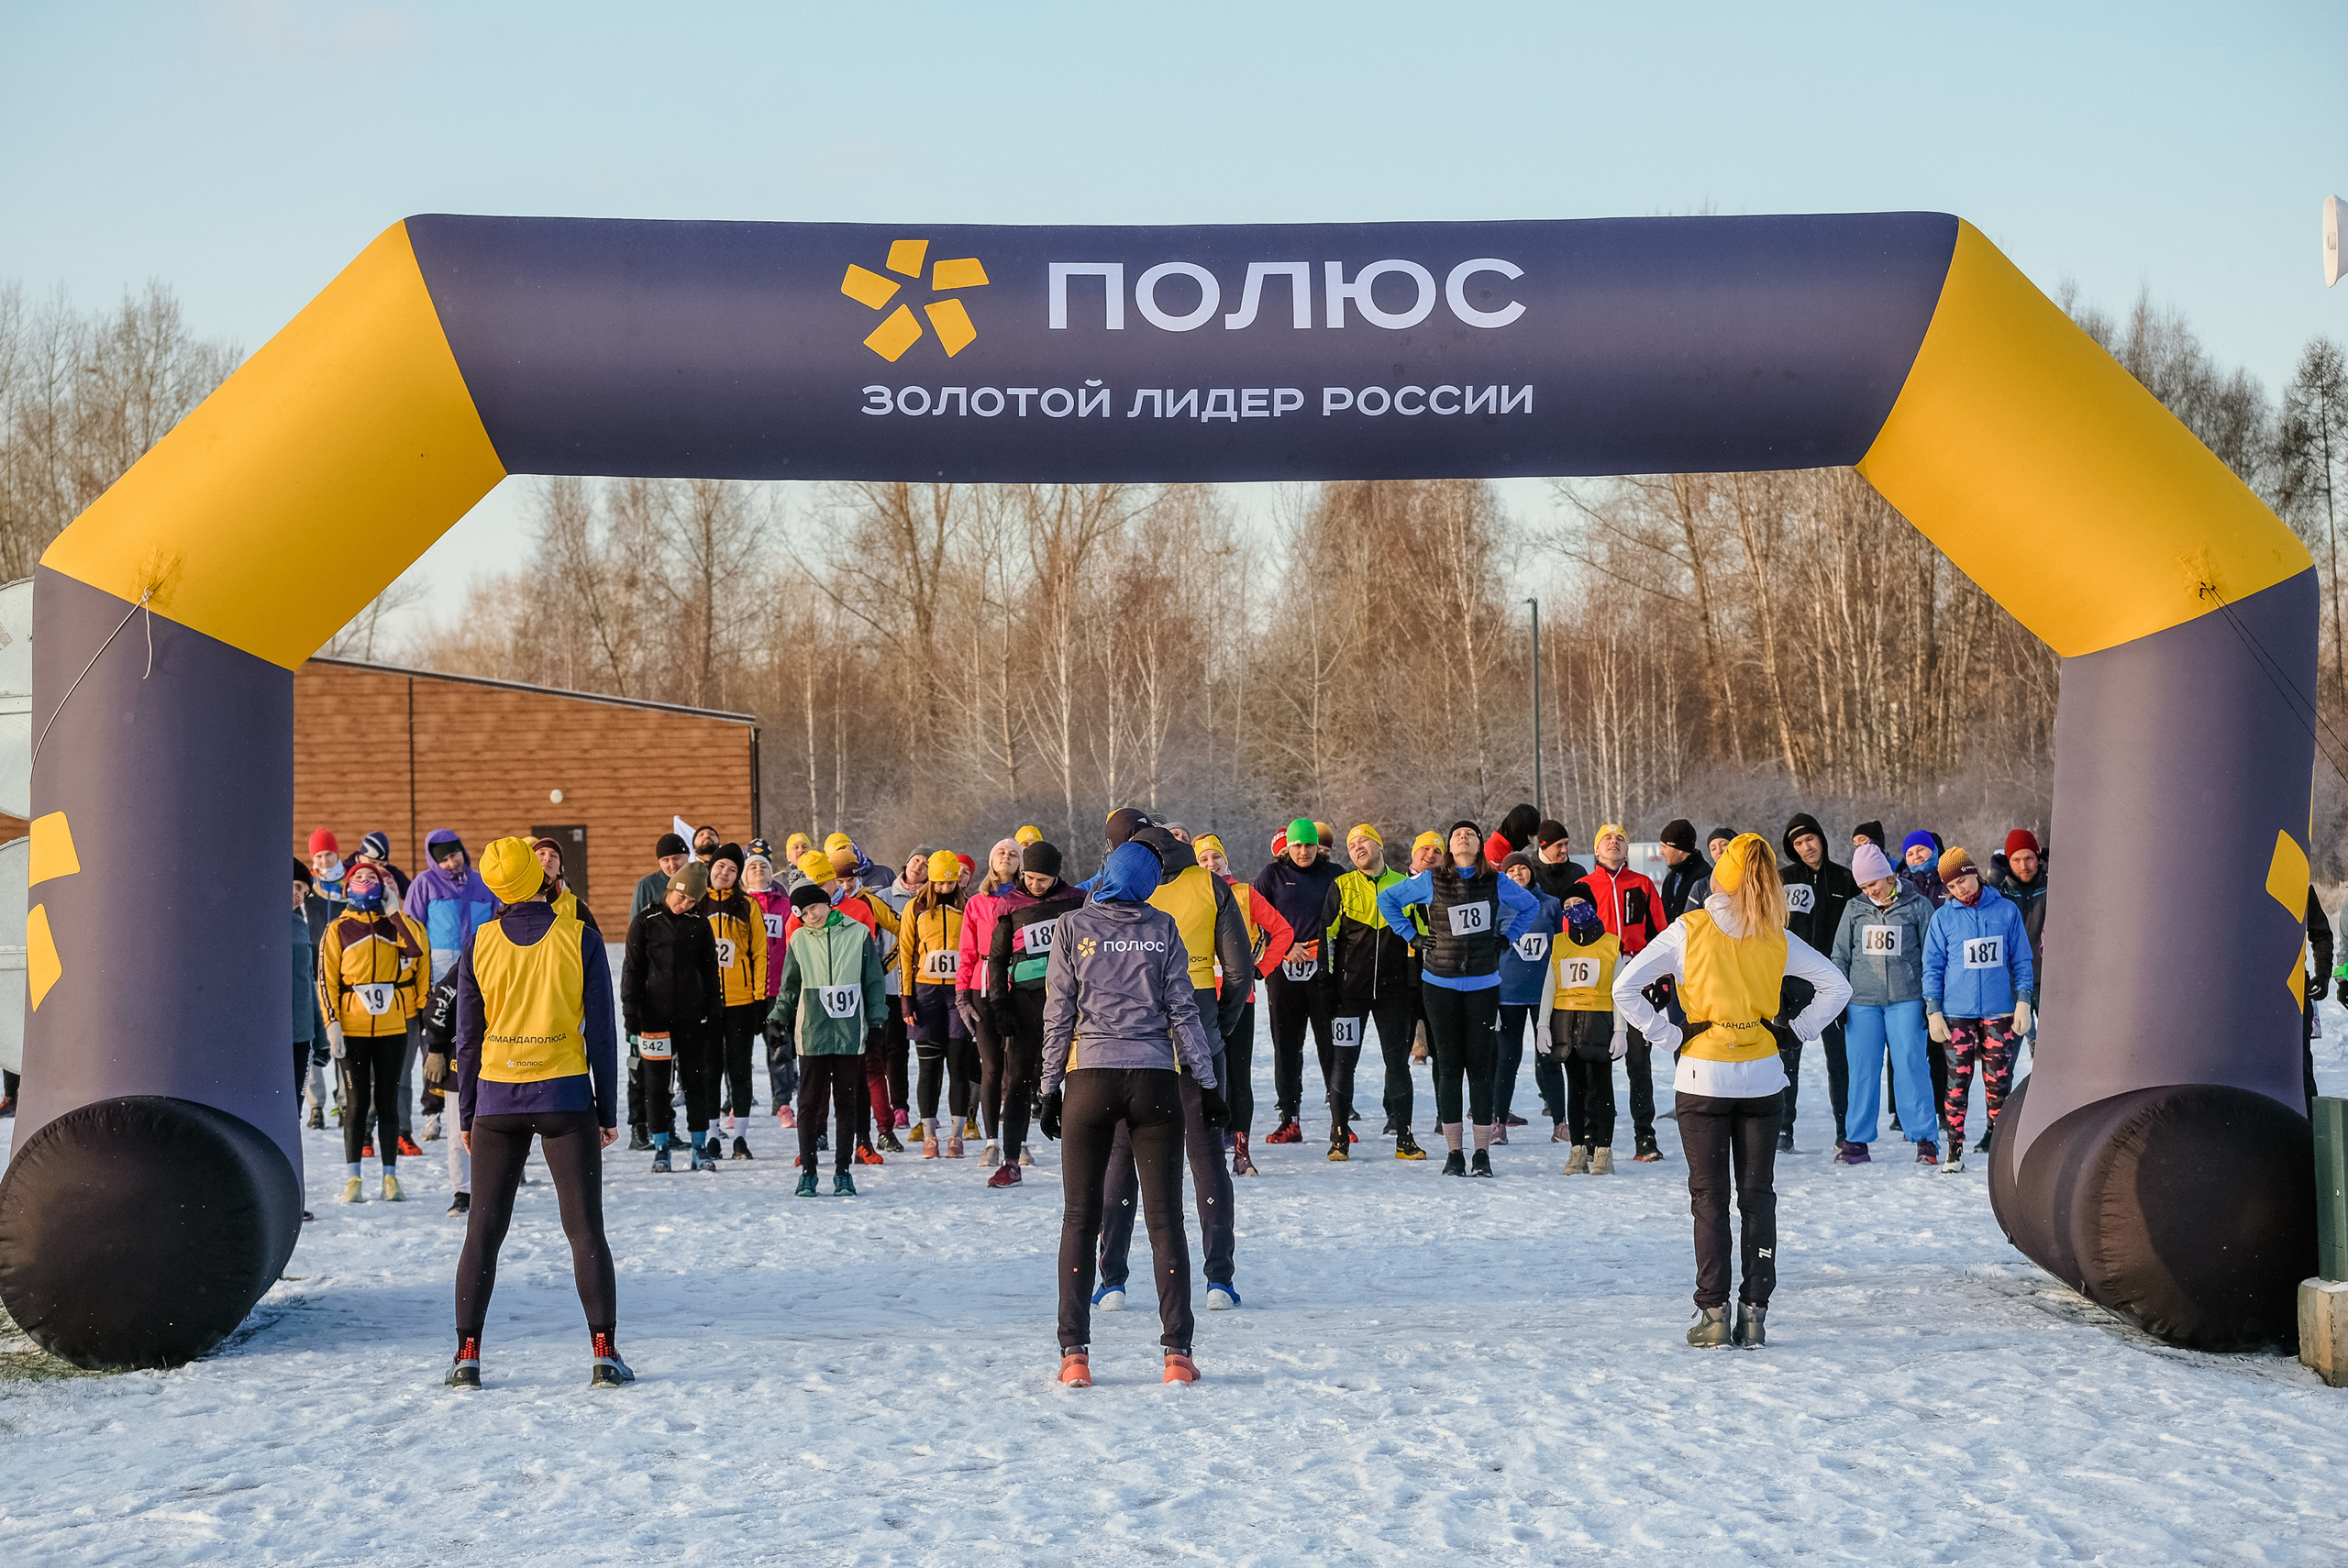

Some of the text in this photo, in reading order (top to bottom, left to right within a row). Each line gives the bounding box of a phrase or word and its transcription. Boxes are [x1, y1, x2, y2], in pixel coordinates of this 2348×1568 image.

[1048, 258, 1527, 332] ПОЛЮС
[860, 379, 1534, 423] ЗОЛОТОЙ ЛИДЕР РОССИИ
[1458, 907, 1481, 929] 78
[1103, 940, 1165, 953] ПОЛЮС
[1523, 938, 1542, 955] 47
[1866, 930, 1895, 950] 186
[1969, 942, 1998, 964] 187
[929, 955, 957, 973] 161
[1288, 961, 1314, 977] 197
[1569, 962, 1589, 982] 76
[826, 989, 855, 1012] 191
[642, 1041, 664, 1052] 542
